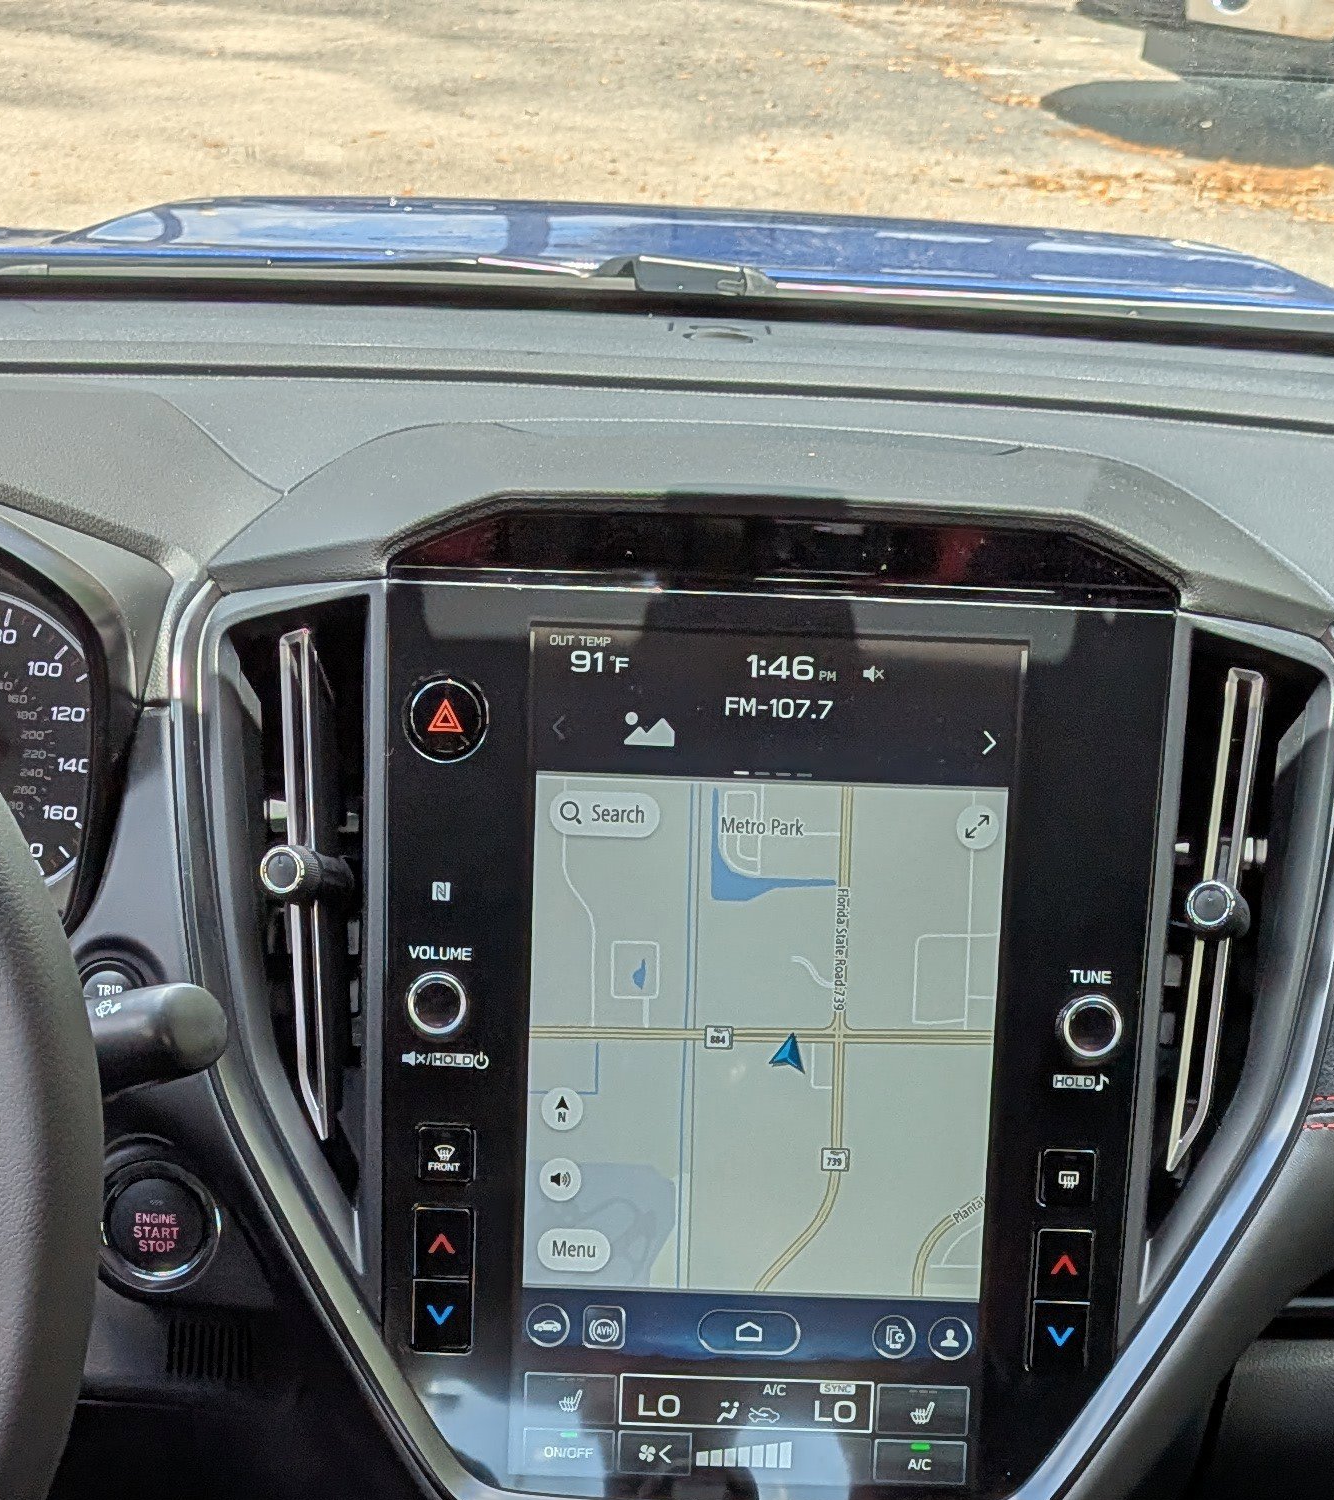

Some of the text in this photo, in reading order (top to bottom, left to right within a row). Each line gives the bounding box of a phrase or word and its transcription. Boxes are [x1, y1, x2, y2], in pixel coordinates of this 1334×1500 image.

[549, 634, 611, 648] OUT TEMP
[27, 661, 62, 677] 100
[747, 654, 837, 681] 1:46 PM
[51, 707, 85, 722] 120
[725, 697, 833, 720] FM-107.7
[57, 758, 89, 773] 140
[42, 805, 77, 820] 160
[591, 804, 645, 823] Search
[721, 817, 804, 836] Metro Park
[409, 945, 472, 960] VOLUME
[834, 888, 849, 1010] Florida State Road 739
[1070, 970, 1111, 984] TUNE
[97, 985, 123, 996] TRIP
[710, 1035, 725, 1044] 884
[434, 1054, 472, 1065] HOLD
[1055, 1076, 1093, 1087] HOLD
[558, 1112, 565, 1122] N
[428, 1162, 460, 1171] FRONT
[827, 1158, 842, 1166] 739
[136, 1213, 177, 1224] ENGINE
[134, 1226, 179, 1239] START
[139, 1240, 175, 1252] STOP
[552, 1240, 596, 1257] Menu
[763, 1384, 786, 1396] A/C
[825, 1385, 851, 1393] SYNC
[638, 1393, 681, 1417] LO
[814, 1400, 856, 1423] LO
[544, 1447, 593, 1458] ON/OFF
[908, 1459, 931, 1471] A/C
